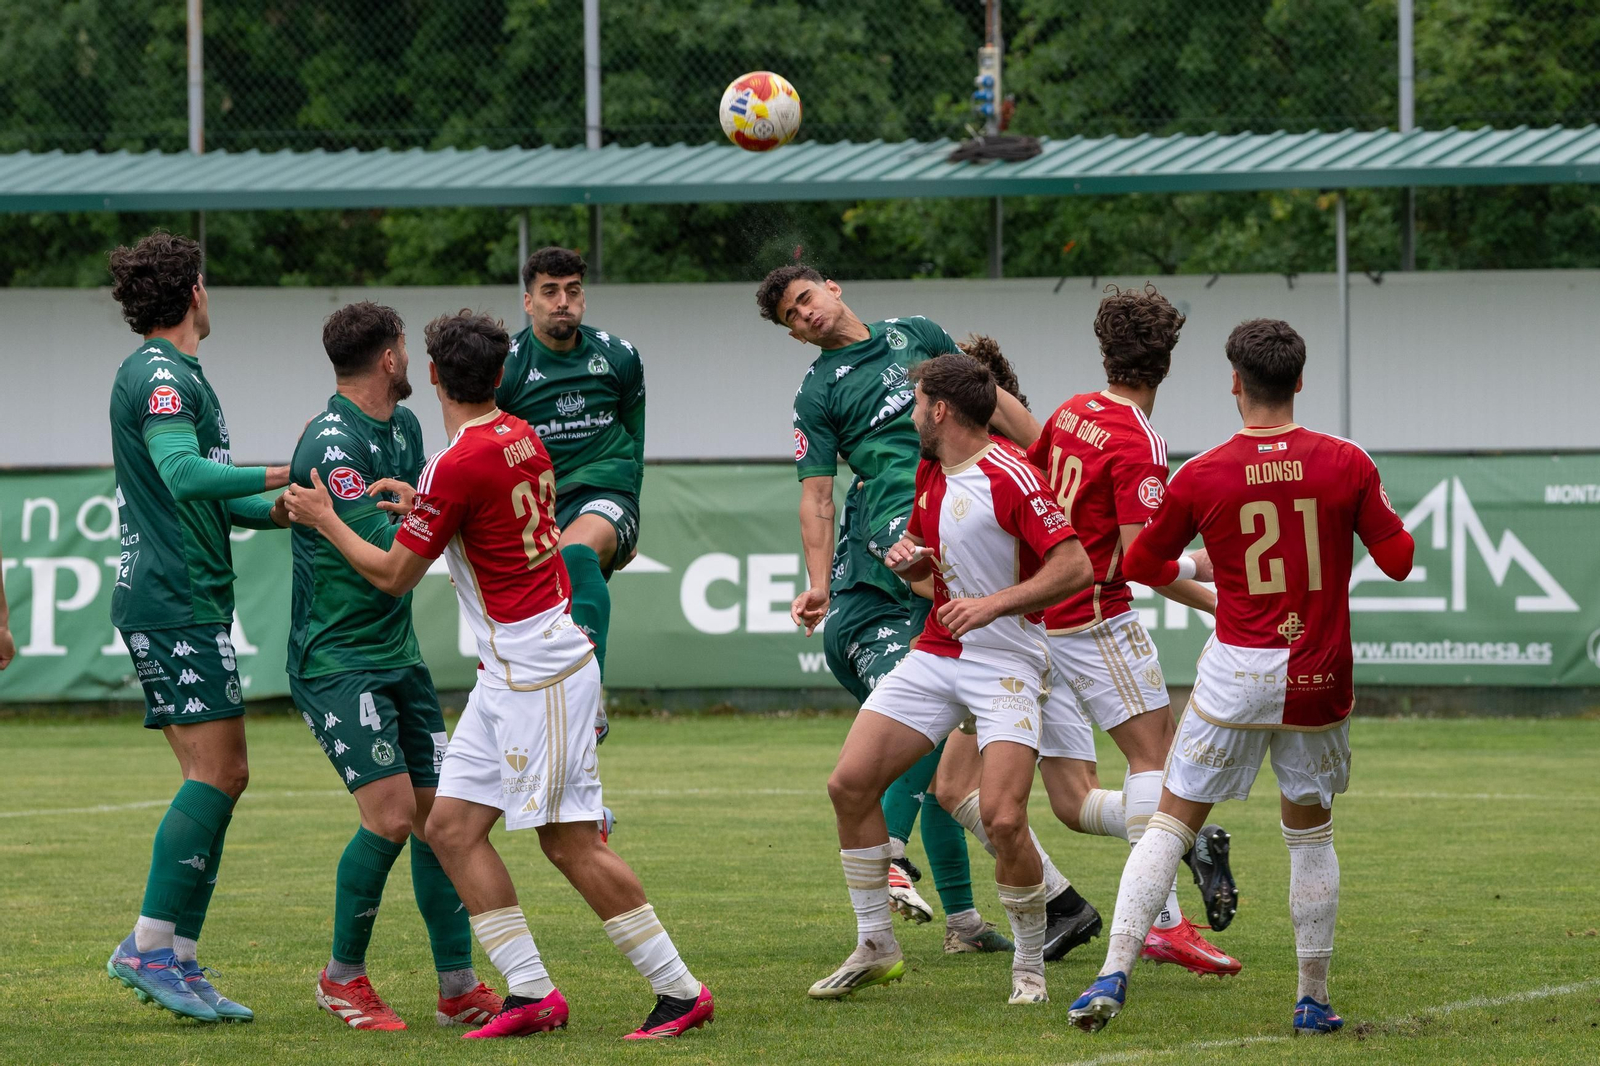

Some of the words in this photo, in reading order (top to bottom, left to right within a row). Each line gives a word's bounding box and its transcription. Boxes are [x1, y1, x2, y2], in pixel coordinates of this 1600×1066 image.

[1055, 407, 1080, 434] CÉSAR
[1076, 419, 1112, 451] GÓMEZ
[503, 436, 538, 468] OSAMA
[1051, 445, 1083, 526] 19
[1245, 460, 1304, 486] ALONSO
[1239, 497, 1323, 596] 21
[214, 631, 237, 672] 9
[1119, 621, 1153, 660] 19
[1235, 671, 1335, 685] PROACSA
[359, 691, 382, 731] 4
[1192, 753, 1236, 769] MEDIO
